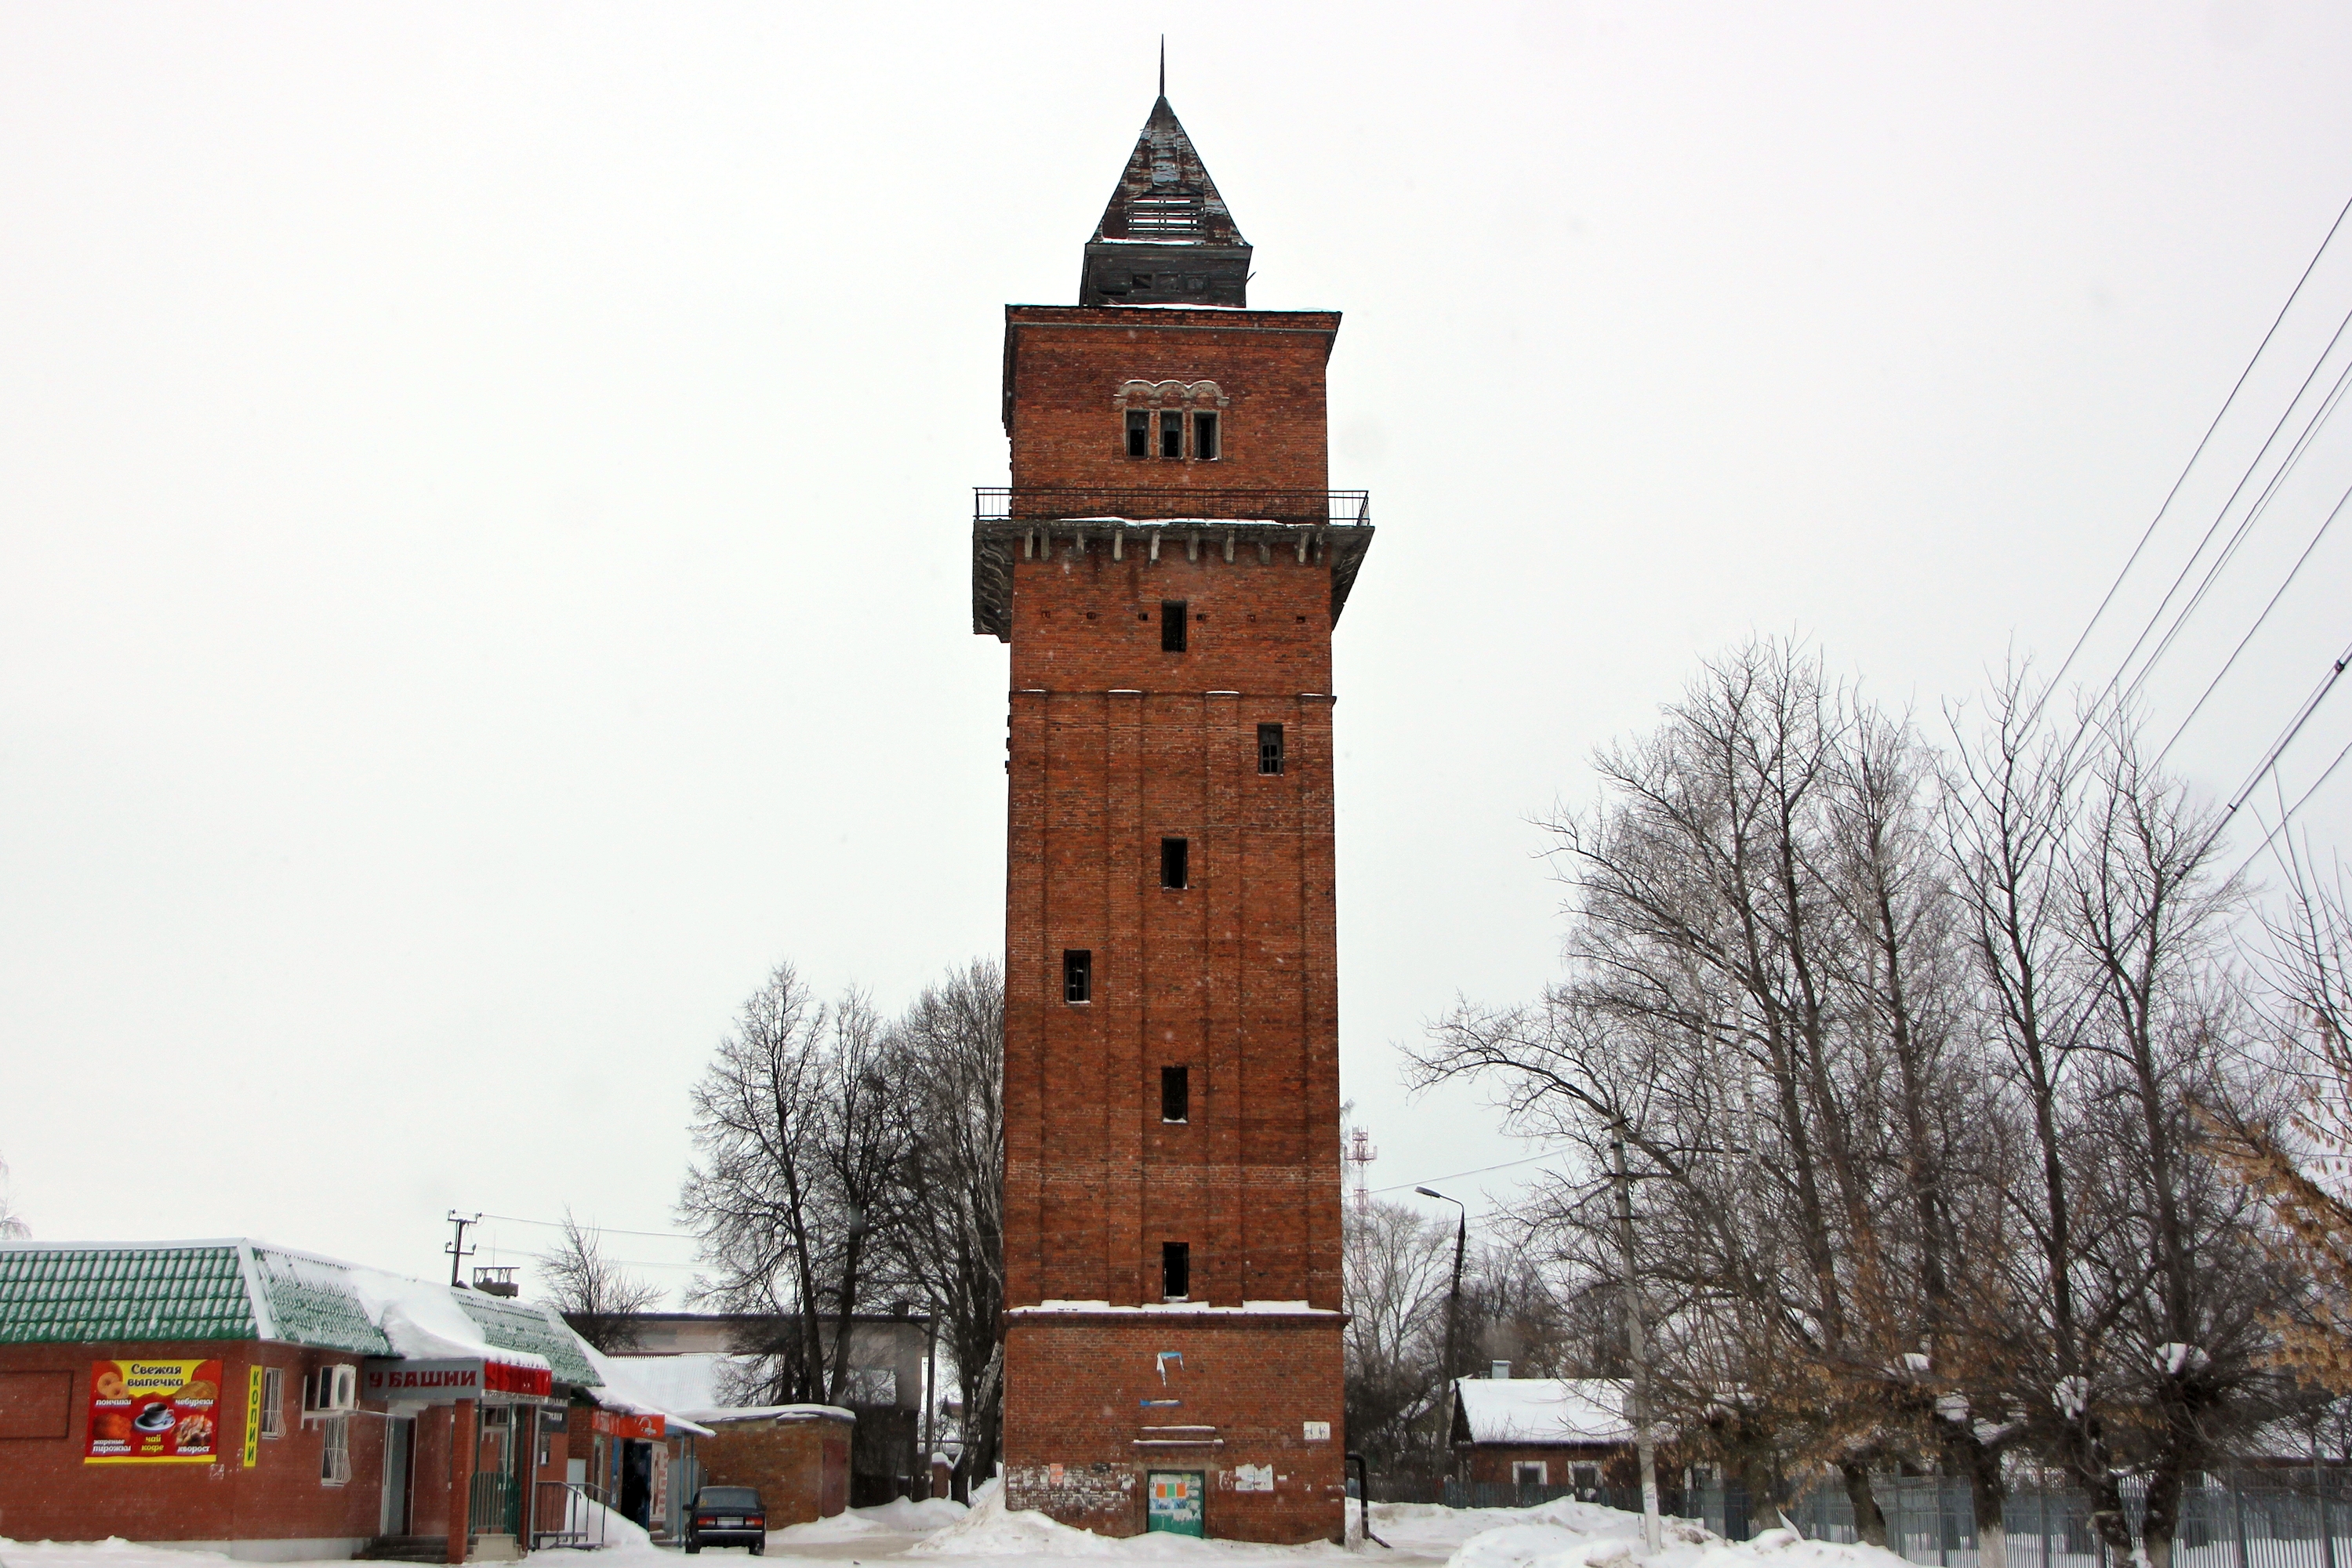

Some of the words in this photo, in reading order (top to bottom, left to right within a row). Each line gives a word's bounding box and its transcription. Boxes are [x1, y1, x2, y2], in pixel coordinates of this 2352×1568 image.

[131, 1363, 182, 1375] Свежая
[127, 1377, 184, 1388] выпечка
[369, 1371, 383, 1388] У
[388, 1370, 477, 1388] БАШНИ
[175, 1397, 214, 1407] чебуреки
[247, 1370, 260, 1461] КОПИИ
[145, 1434, 162, 1443] чай
[92, 1445, 132, 1454] пирожки
[141, 1443, 165, 1453] кофе
[176, 1445, 211, 1454] хворост
